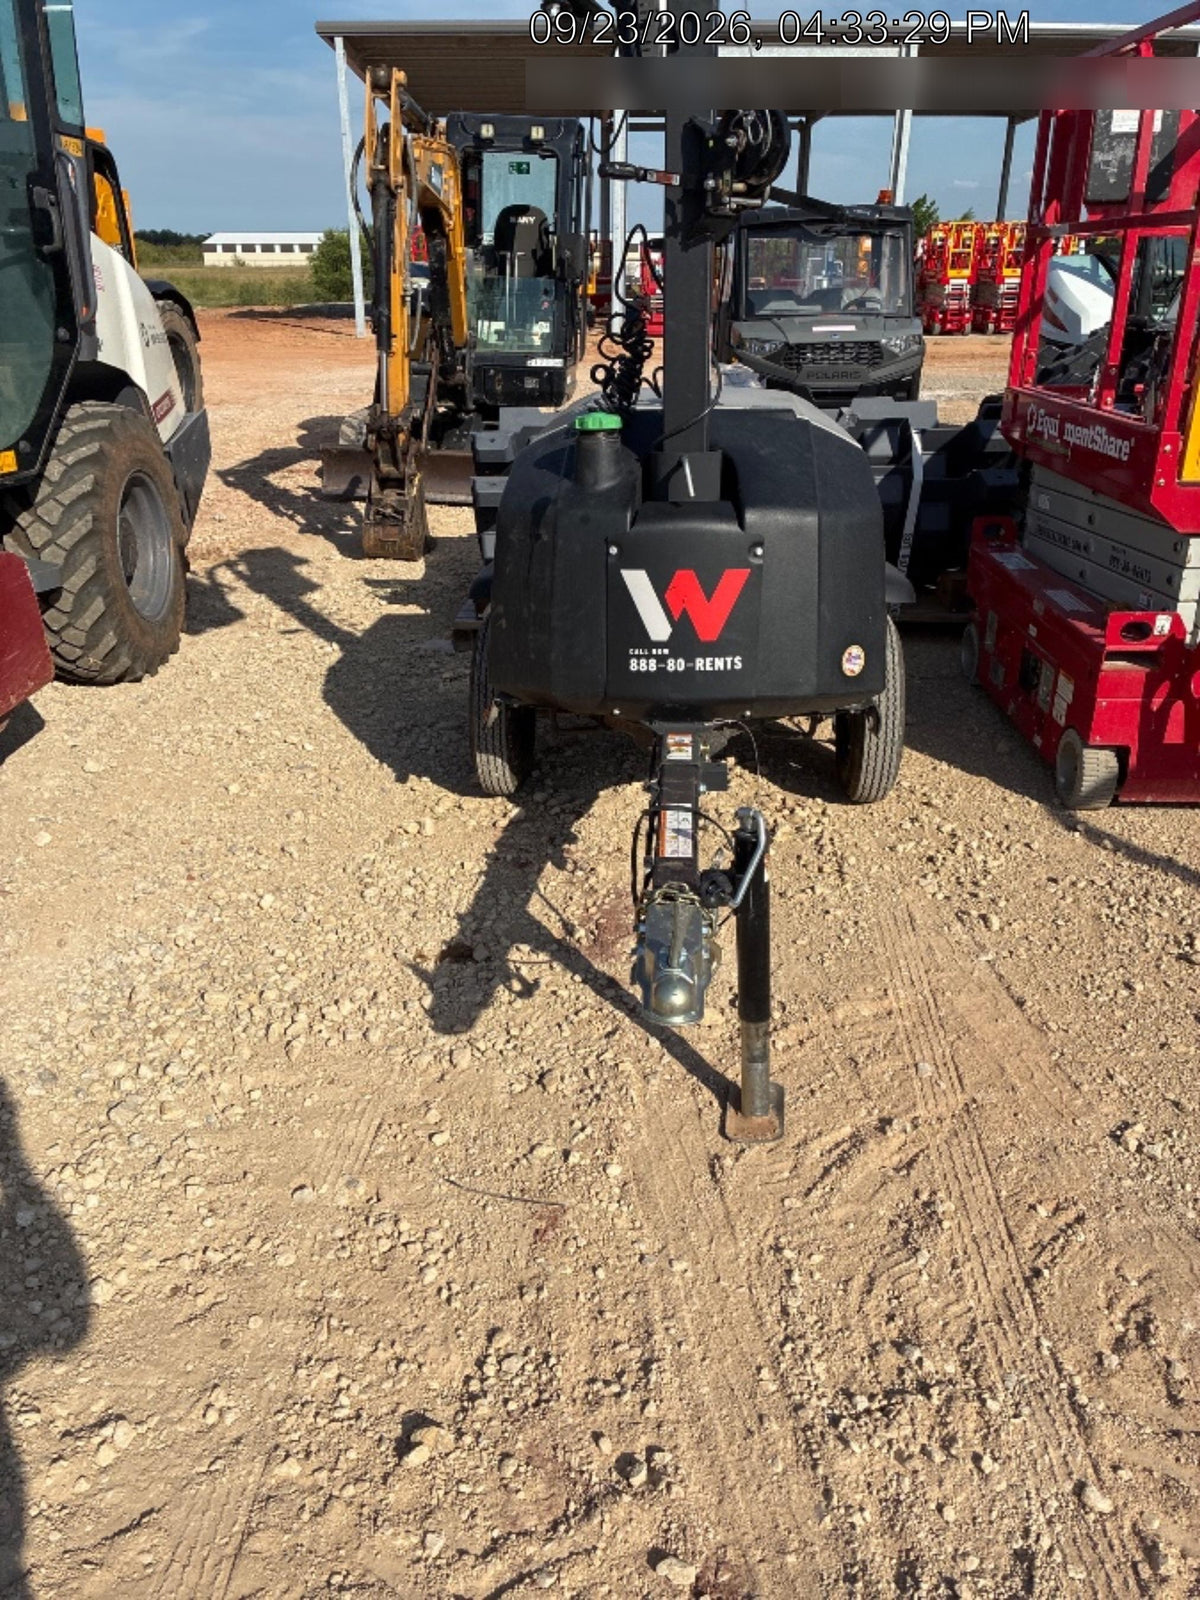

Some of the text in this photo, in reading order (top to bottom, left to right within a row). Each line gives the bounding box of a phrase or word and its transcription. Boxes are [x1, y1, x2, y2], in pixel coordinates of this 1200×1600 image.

[806, 371, 861, 380] POLARIS
[1037, 408, 1131, 461] EquimentShare
[629, 656, 743, 672] 888-80-RENTS
